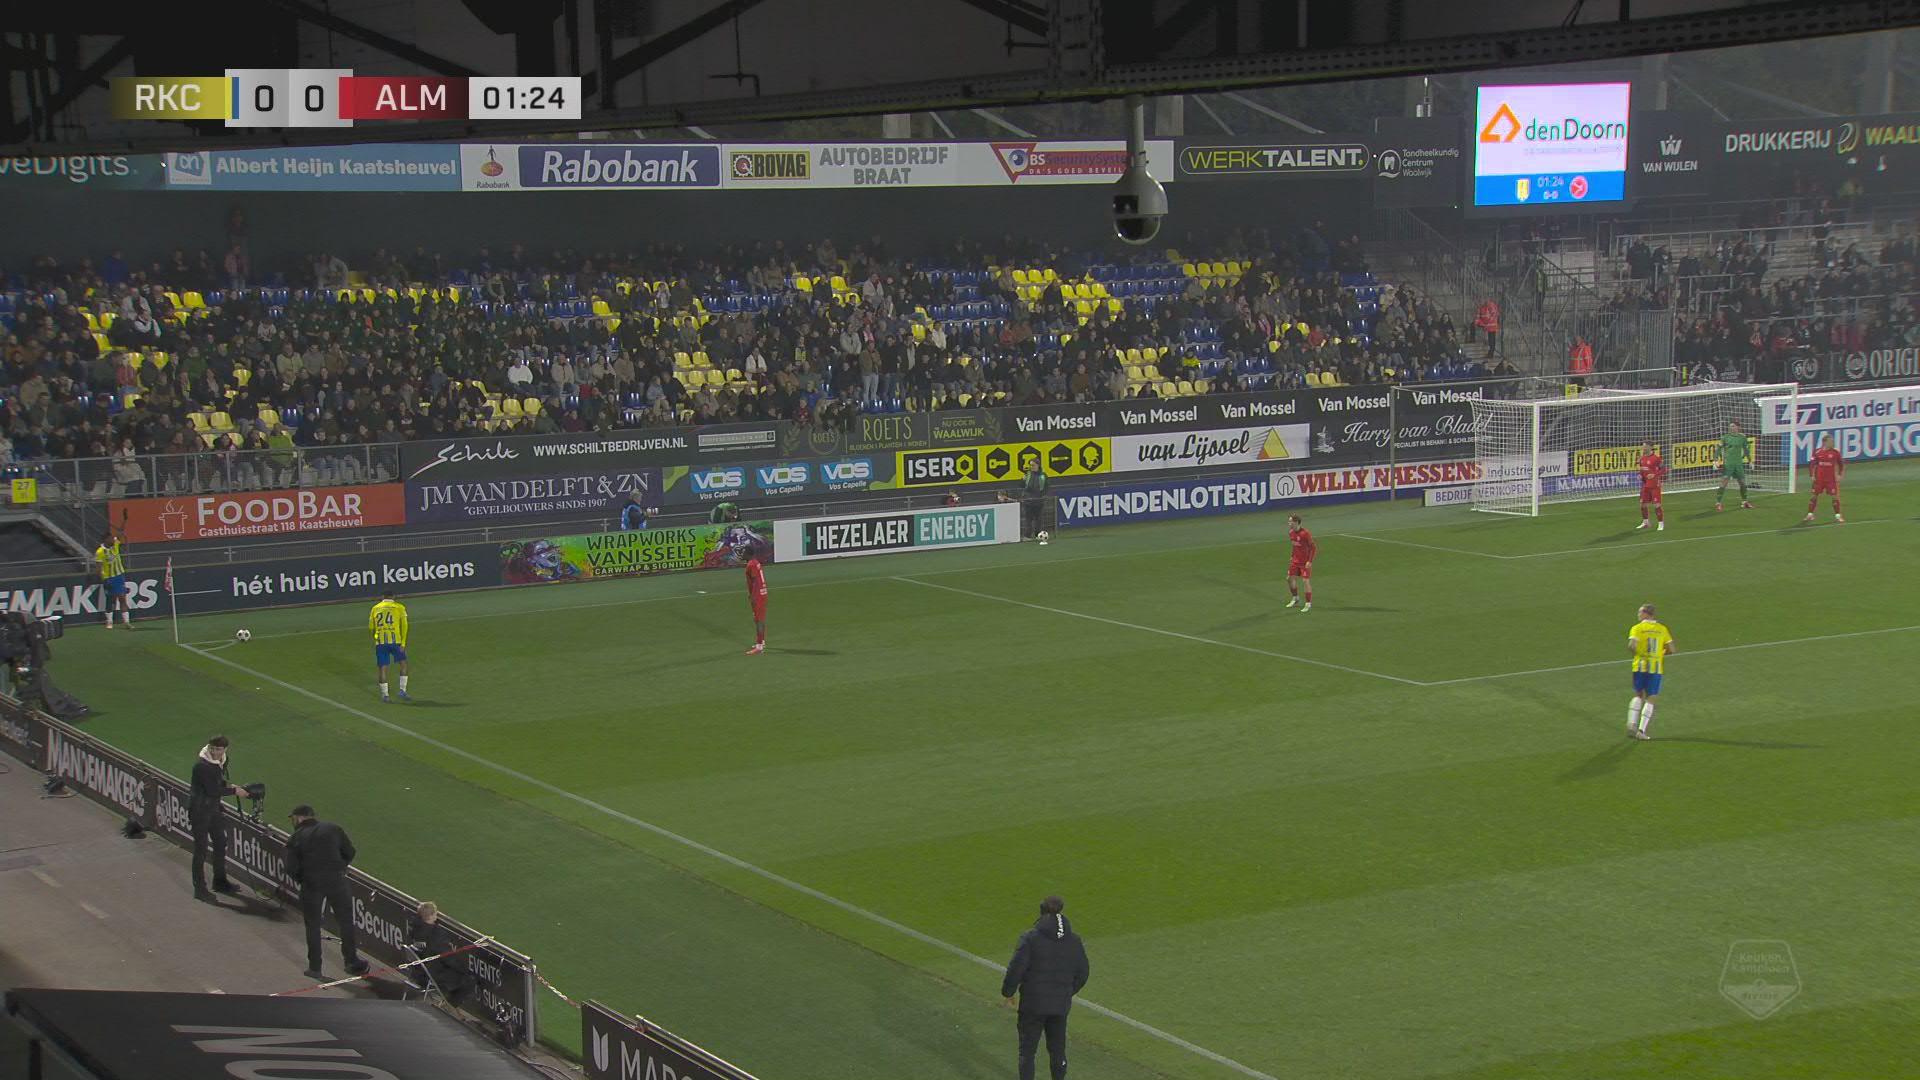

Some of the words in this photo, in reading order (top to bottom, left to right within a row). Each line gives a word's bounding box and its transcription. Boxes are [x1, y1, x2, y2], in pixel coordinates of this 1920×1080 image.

[1726, 129, 1832, 153] DRUKKERIJ
[542, 150, 699, 183] Rabobank
[754, 154, 806, 178] BOVAG
[819, 147, 949, 166] AUTOBEDRIJF
[1402, 159, 1434, 167] Centrum
[1643, 162, 1662, 173] VAN
[1664, 160, 1698, 172] WIJLEN
[215, 157, 279, 174] Albert
[283, 157, 335, 178] Heijn
[339, 158, 457, 176] Kaatsheuvel
[853, 168, 912, 185] BRAAT
[476, 181, 510, 189] Rabobank
[1318, 397, 1343, 412] Van
[1346, 392, 1391, 410] Mossel
[1413, 391, 1436, 406] Van
[1440, 387, 1483, 404] Mossel
[1120, 410, 1146, 425] Van
[1150, 405, 1198, 423] Mossel
[1221, 404, 1246, 419] Van
[1250, 399, 1296, 417] Mossel
[1826, 404, 1857, 420] van
[1863, 400, 1893, 417] der
[863, 416, 913, 442] ROETS
[1016, 416, 1043, 432] Van
[1047, 411, 1096, 430] Mossel
[933, 427, 985, 439] WAALWIJK
[1341, 421, 1392, 448] Harry
[1399, 424, 1431, 439] van
[409, 441, 521, 480] Schilt
[533, 437, 689, 458] WWW.SCHILTBEDRIJVEN.NL
[1138, 443, 1177, 462] van
[1178, 431, 1251, 465] Lijssel
[824, 462, 870, 480] VOS
[1577, 452, 1601, 473] PRO
[694, 472, 743, 489] VOS
[759, 466, 807, 485] VOS
[1297, 468, 1370, 494] WILLY
[1373, 462, 1483, 489] NAESSENS
[456, 481, 507, 503] VAN
[510, 476, 594, 500] DELFT
[597, 475, 617, 499] &
[617, 472, 649, 493] ZN
[1435, 487, 1473, 502] BEDRIJF
[556, 499, 587, 510] SINDS
[588, 498, 607, 508] 1907
[1059, 482, 1267, 519] VRIENDENLOTERIJ
[199, 523, 279, 537] Gasthuisstraat
[280, 521, 296, 531] 118
[299, 515, 364, 530] Kaatsheuvel
[816, 519, 909, 551] HEZELAER
[920, 513, 990, 544] ENERGY
[587, 528, 697, 551] WRAPWORKS
[595, 564, 642, 575] CARWRAP
[643, 562, 651, 572] &
[652, 560, 693, 570] SIGNING
[233, 574, 273, 597] hét
[280, 571, 330, 593] huis
[335, 569, 376, 588] van
[383, 561, 476, 584] keukens
[376, 612, 393, 627] 24
[48, 728, 145, 817] MANDEMAKERS
[468, 955, 503, 987] EVENTS
